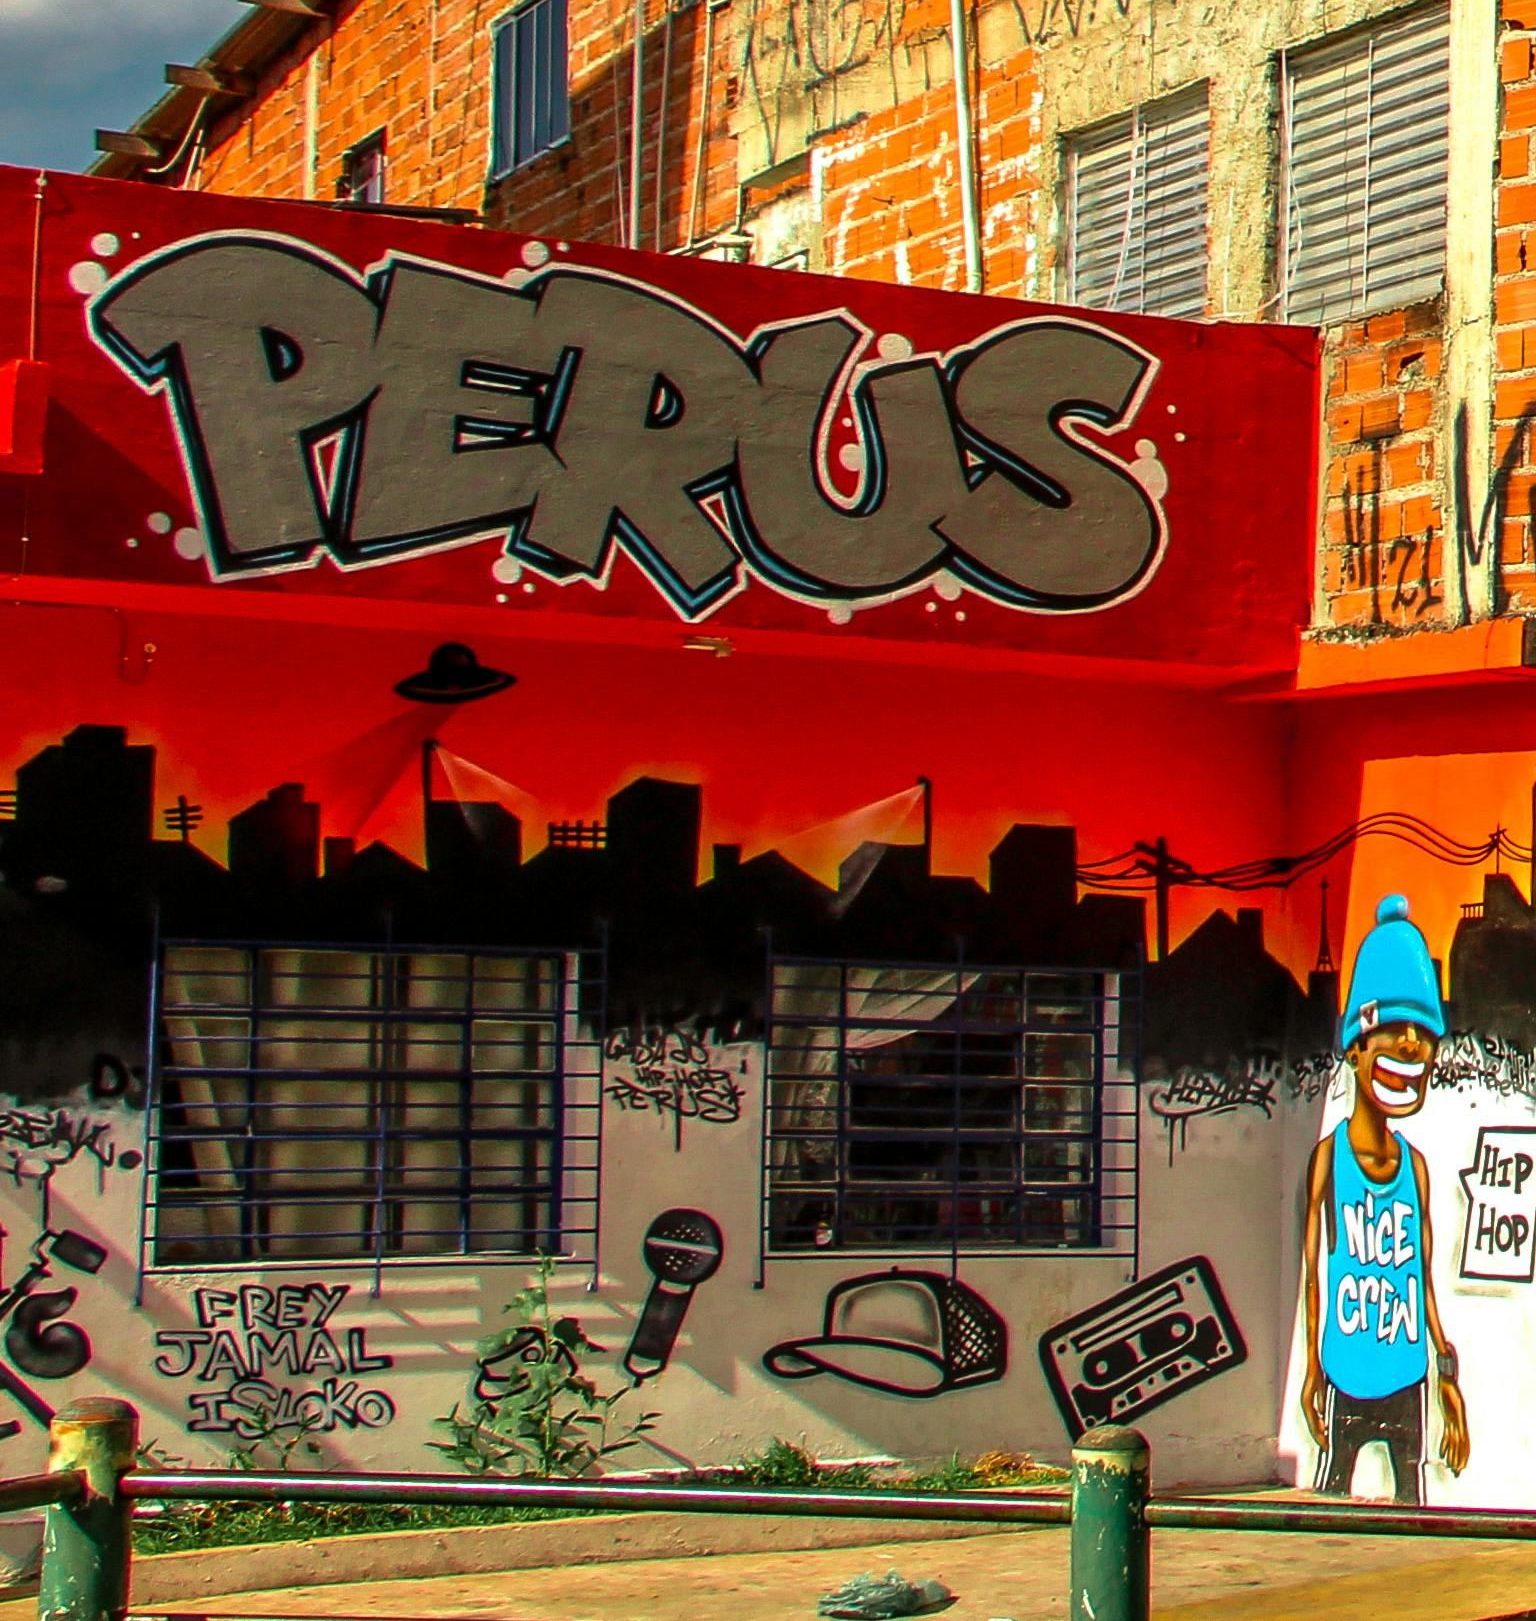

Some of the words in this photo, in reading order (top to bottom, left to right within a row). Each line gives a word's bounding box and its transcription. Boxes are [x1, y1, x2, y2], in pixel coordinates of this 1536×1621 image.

[88, 228, 1168, 622] PERUS
[1480, 1144, 1533, 1194] HIP
[1475, 1203, 1529, 1257] HOP
[195, 1283, 350, 1329] FREY
[155, 1327, 395, 1381] JAMAL
